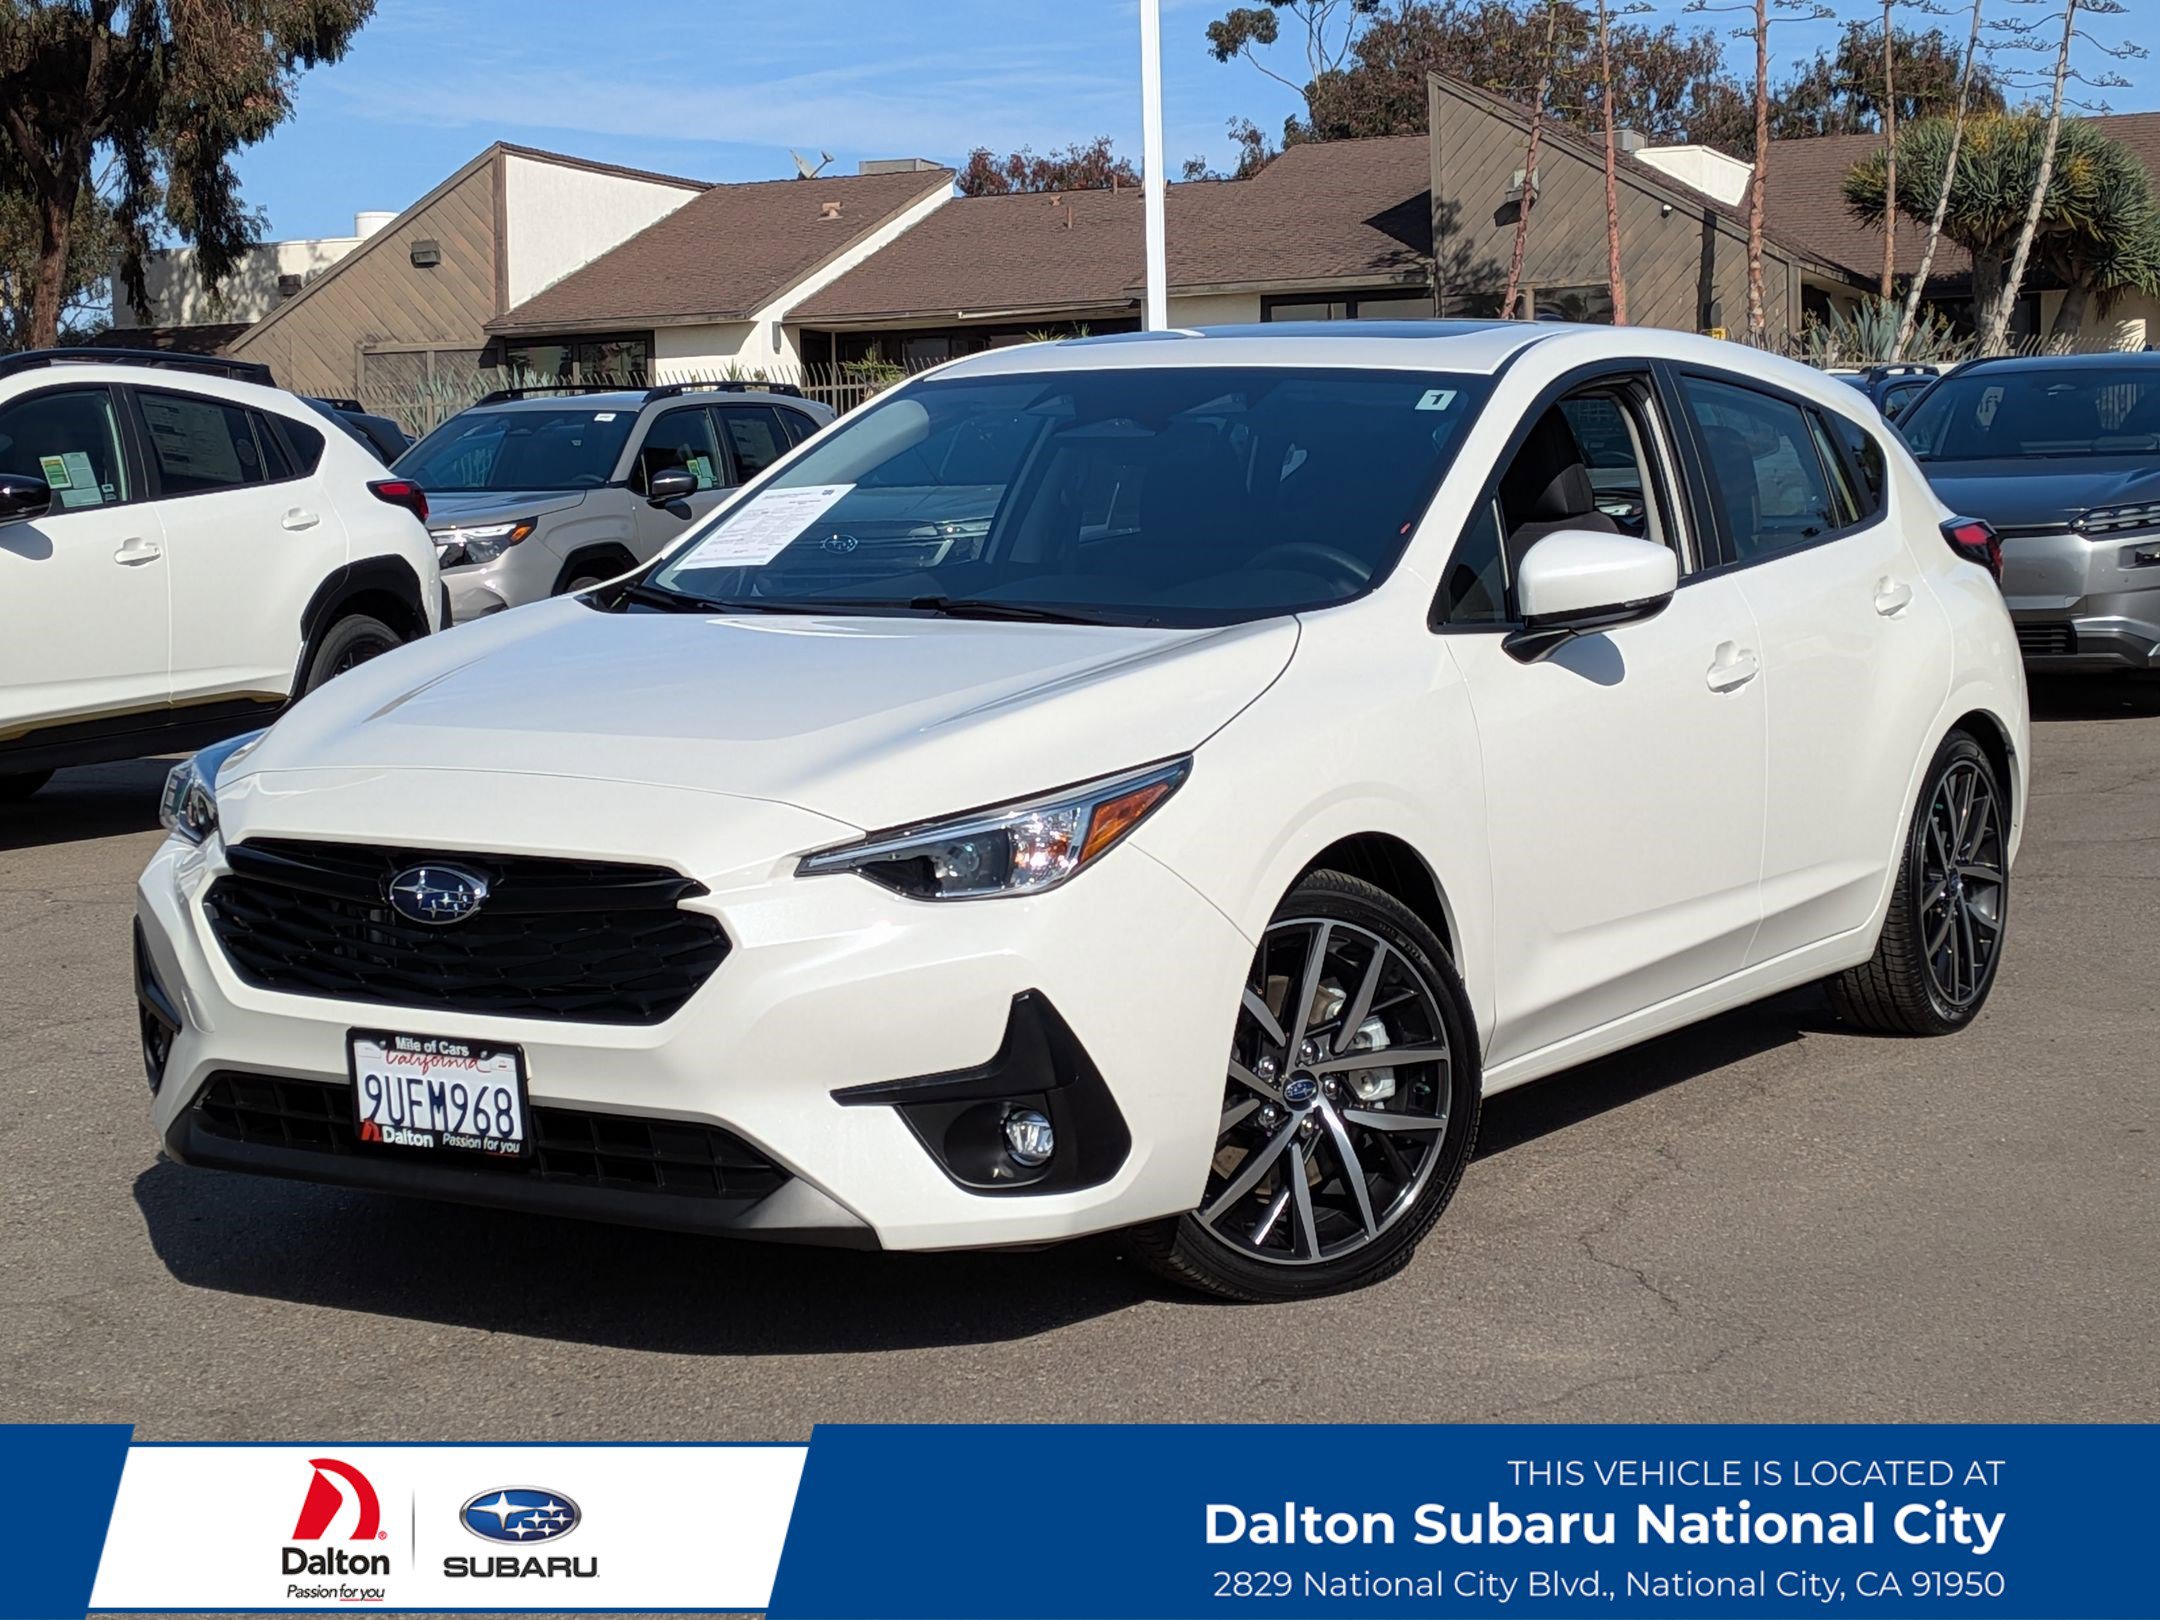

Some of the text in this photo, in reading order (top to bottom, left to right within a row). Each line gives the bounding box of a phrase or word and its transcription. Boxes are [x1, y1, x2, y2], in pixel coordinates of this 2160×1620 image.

[395, 1036, 470, 1057] Mile of Cars
[386, 1049, 491, 1075] California
[365, 1074, 515, 1138] 9UFM968
[382, 1126, 434, 1148] Dalton
[443, 1132, 520, 1154] Passion for you
